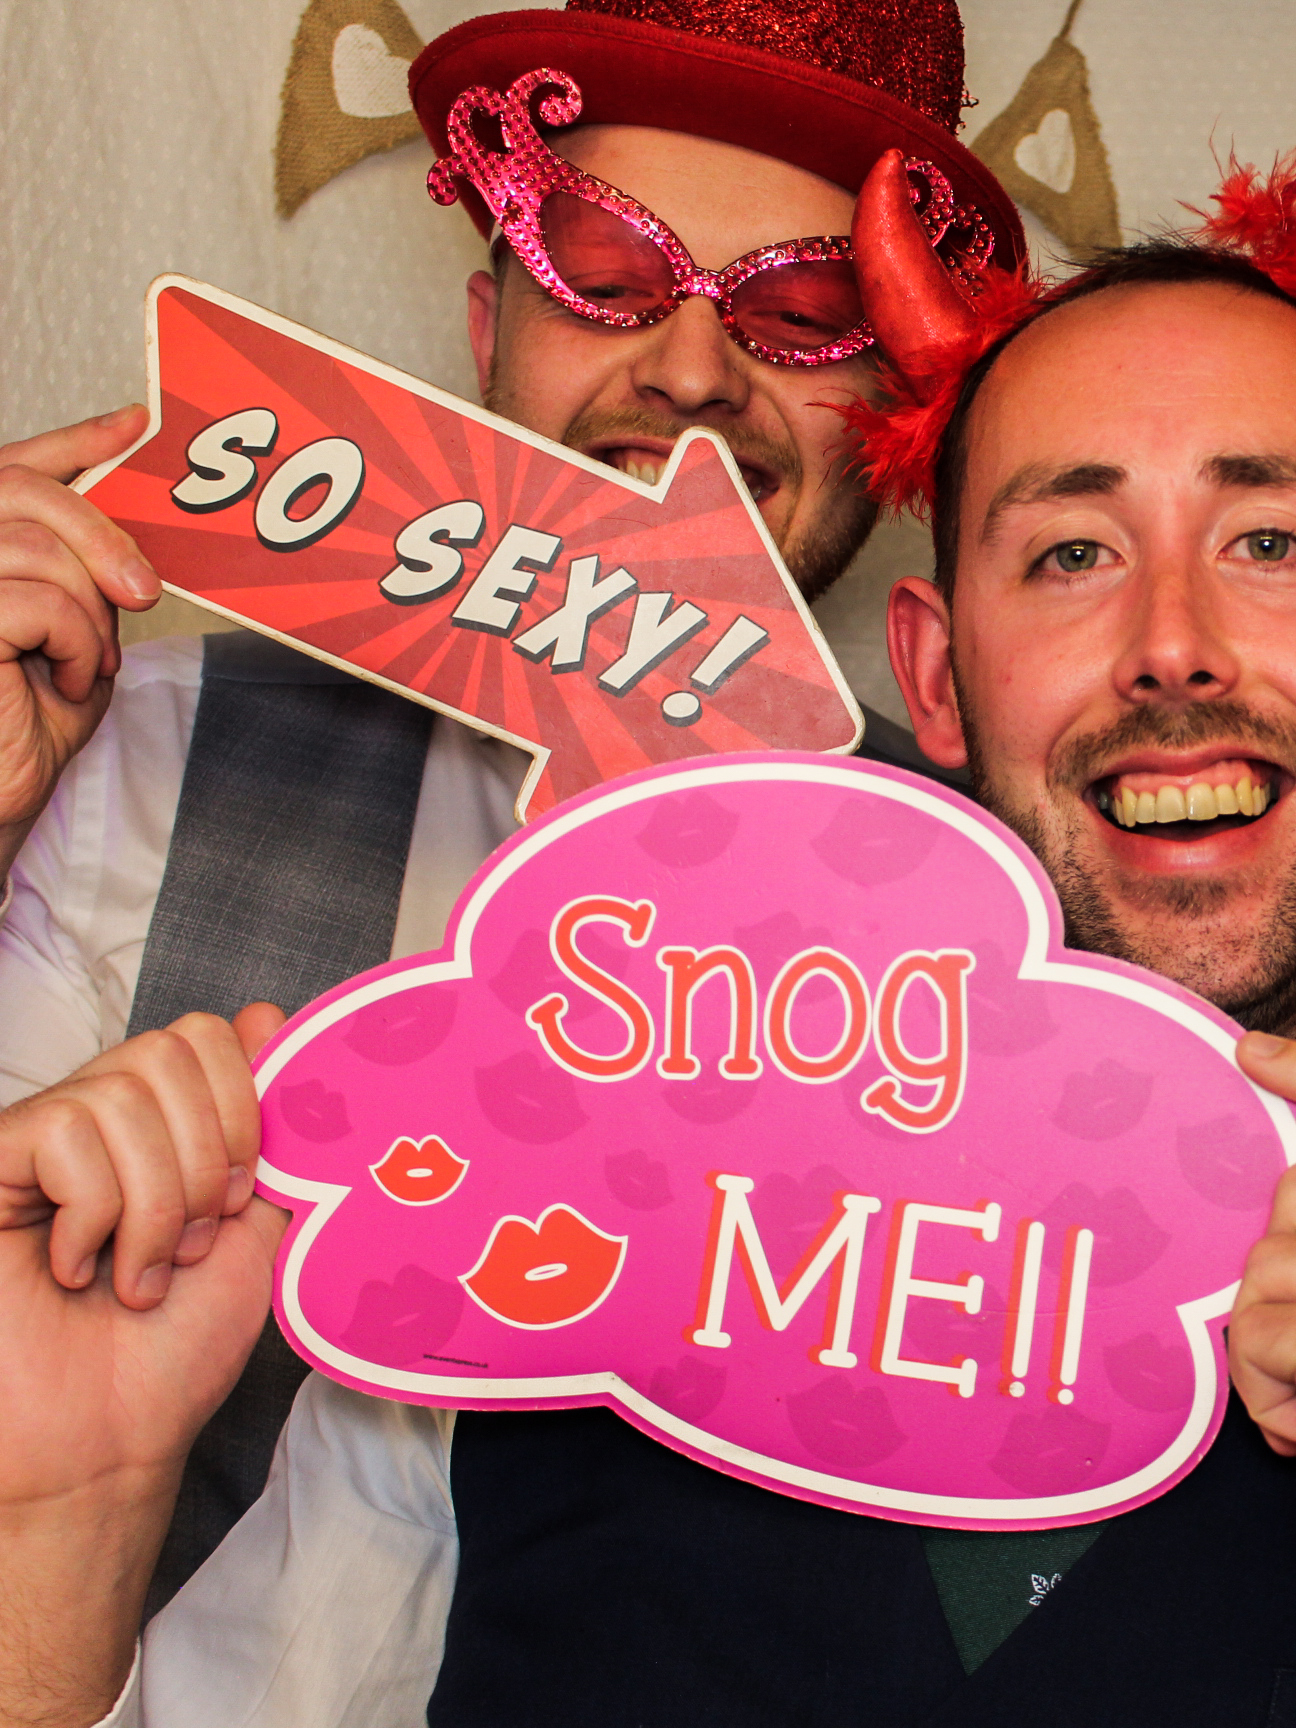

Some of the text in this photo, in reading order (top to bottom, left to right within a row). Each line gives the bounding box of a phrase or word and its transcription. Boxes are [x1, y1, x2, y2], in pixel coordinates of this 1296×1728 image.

[170, 407, 770, 728] SO SEXY!
[525, 895, 977, 1135] Snog
[682, 1168, 1096, 1406] ME!!
